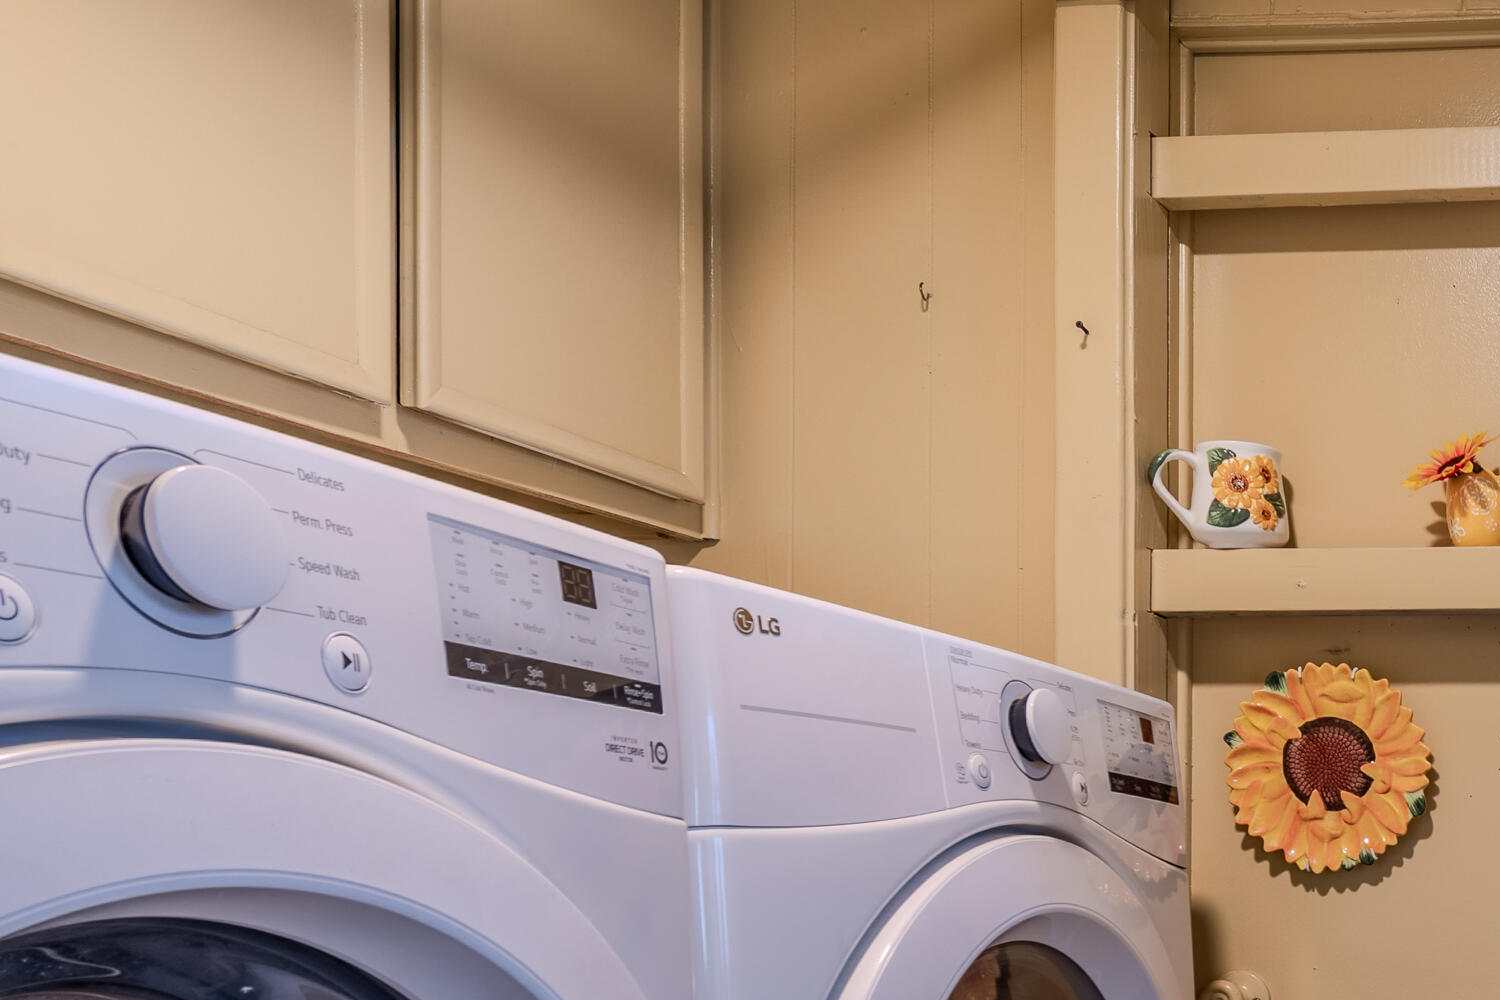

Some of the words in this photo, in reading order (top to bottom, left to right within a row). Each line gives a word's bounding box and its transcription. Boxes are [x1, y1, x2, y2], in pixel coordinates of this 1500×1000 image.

[297, 468, 345, 491] Delicates
[292, 510, 323, 530] Perm.
[325, 519, 353, 537] Press
[298, 556, 331, 575] Speed
[334, 564, 360, 581] Wash
[317, 605, 336, 620] Tub
[339, 609, 367, 626] Clean
[757, 615, 781, 636] LG
[465, 658, 489, 674] Temp.
[527, 665, 544, 680] Spin
[583, 681, 597, 693] Soil
[649, 740, 668, 765] 10
